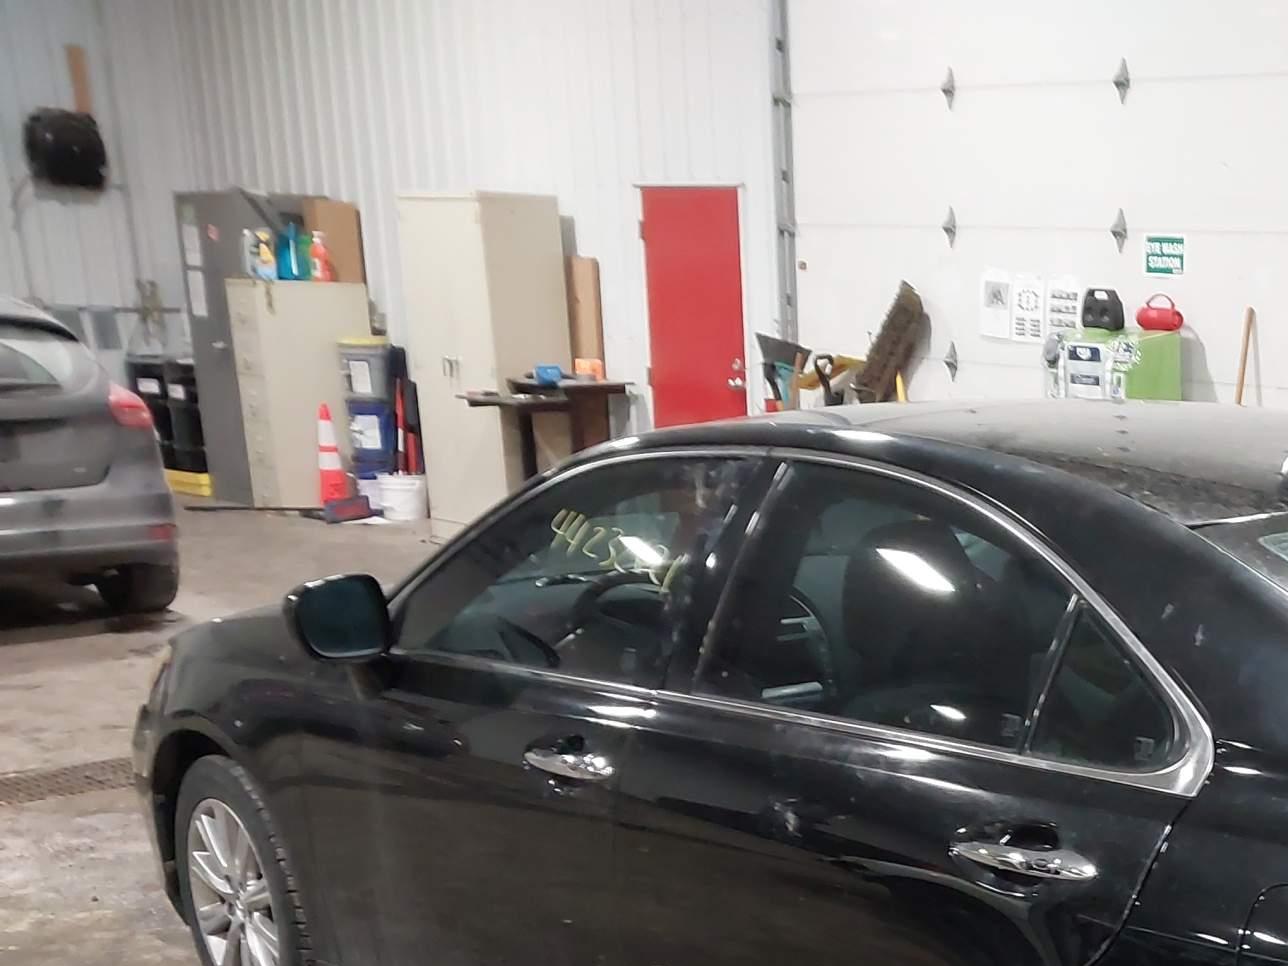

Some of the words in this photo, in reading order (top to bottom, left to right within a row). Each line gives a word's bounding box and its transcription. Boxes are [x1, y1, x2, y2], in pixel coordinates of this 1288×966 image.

[1145, 241, 1162, 254] EYE
[1162, 242, 1184, 256] WASH
[1148, 255, 1182, 269] STATION
